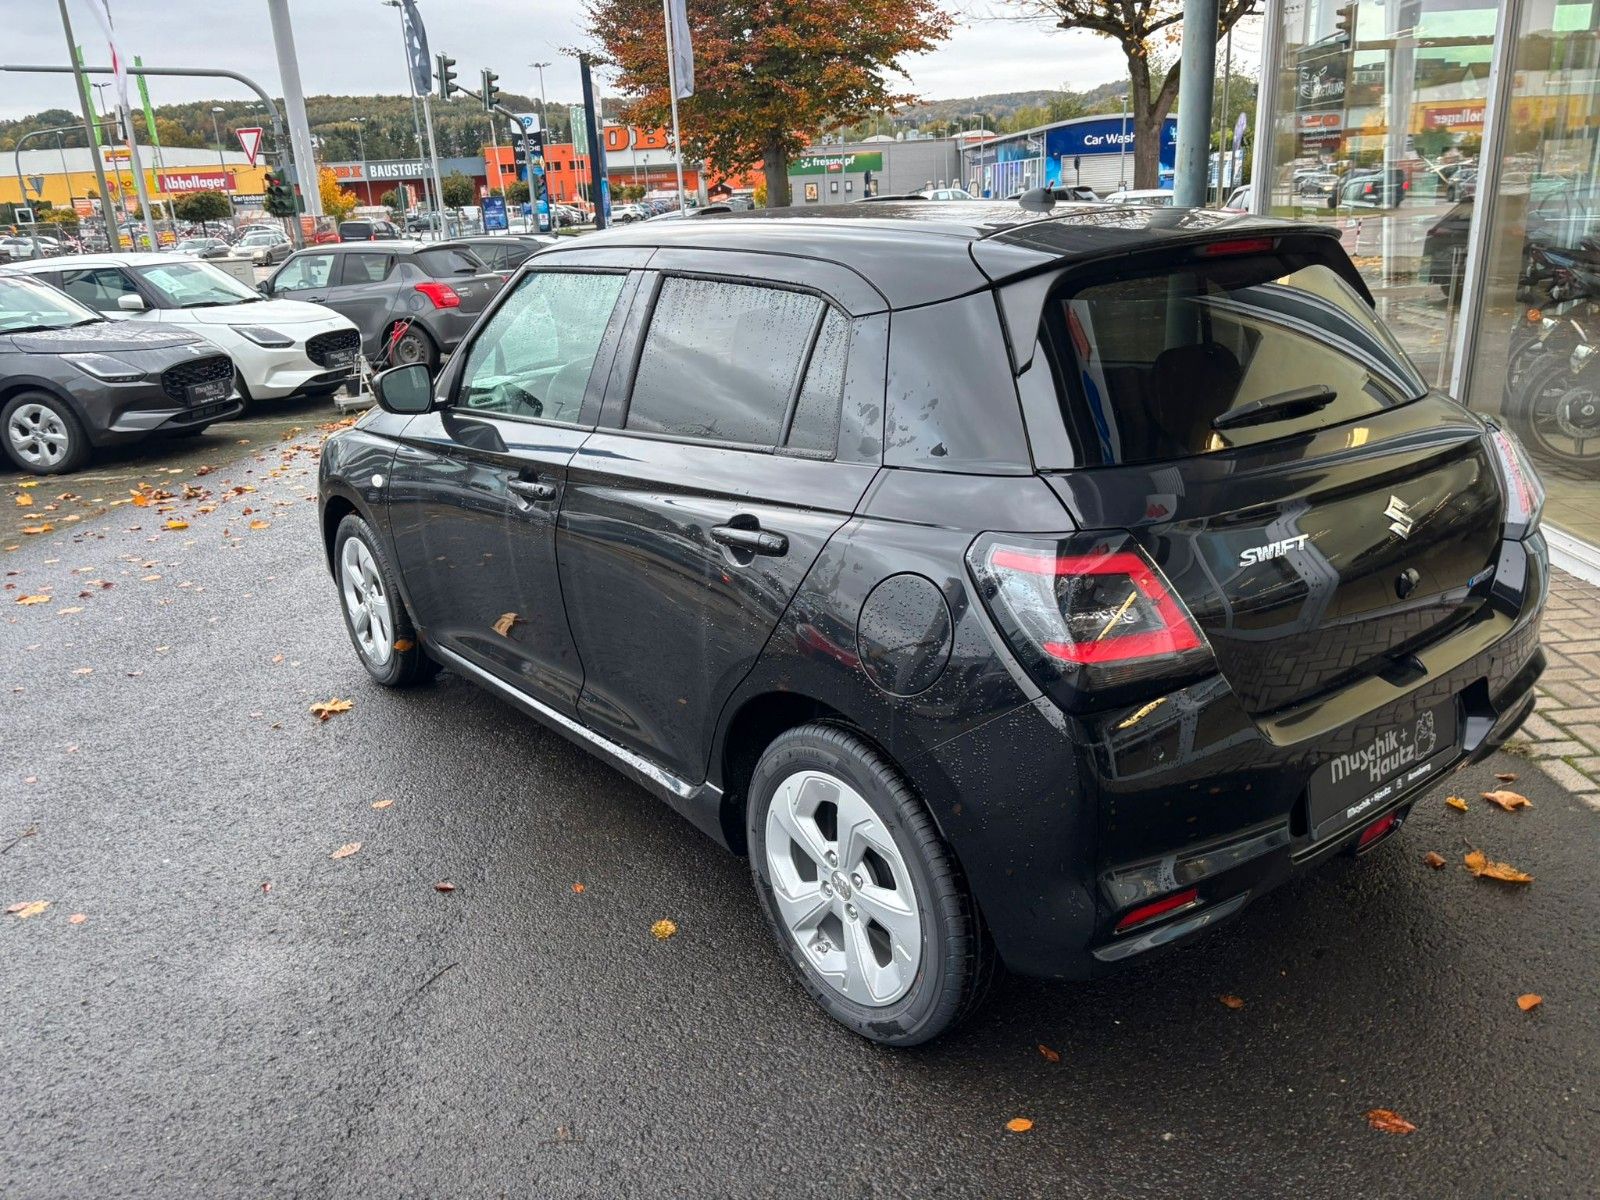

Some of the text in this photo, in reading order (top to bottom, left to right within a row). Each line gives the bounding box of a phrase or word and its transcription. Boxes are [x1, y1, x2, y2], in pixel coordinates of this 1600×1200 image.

[604, 125, 668, 152] OB
[1084, 131, 1135, 146] Car Wash
[1239, 533, 1309, 568] SWIFT
